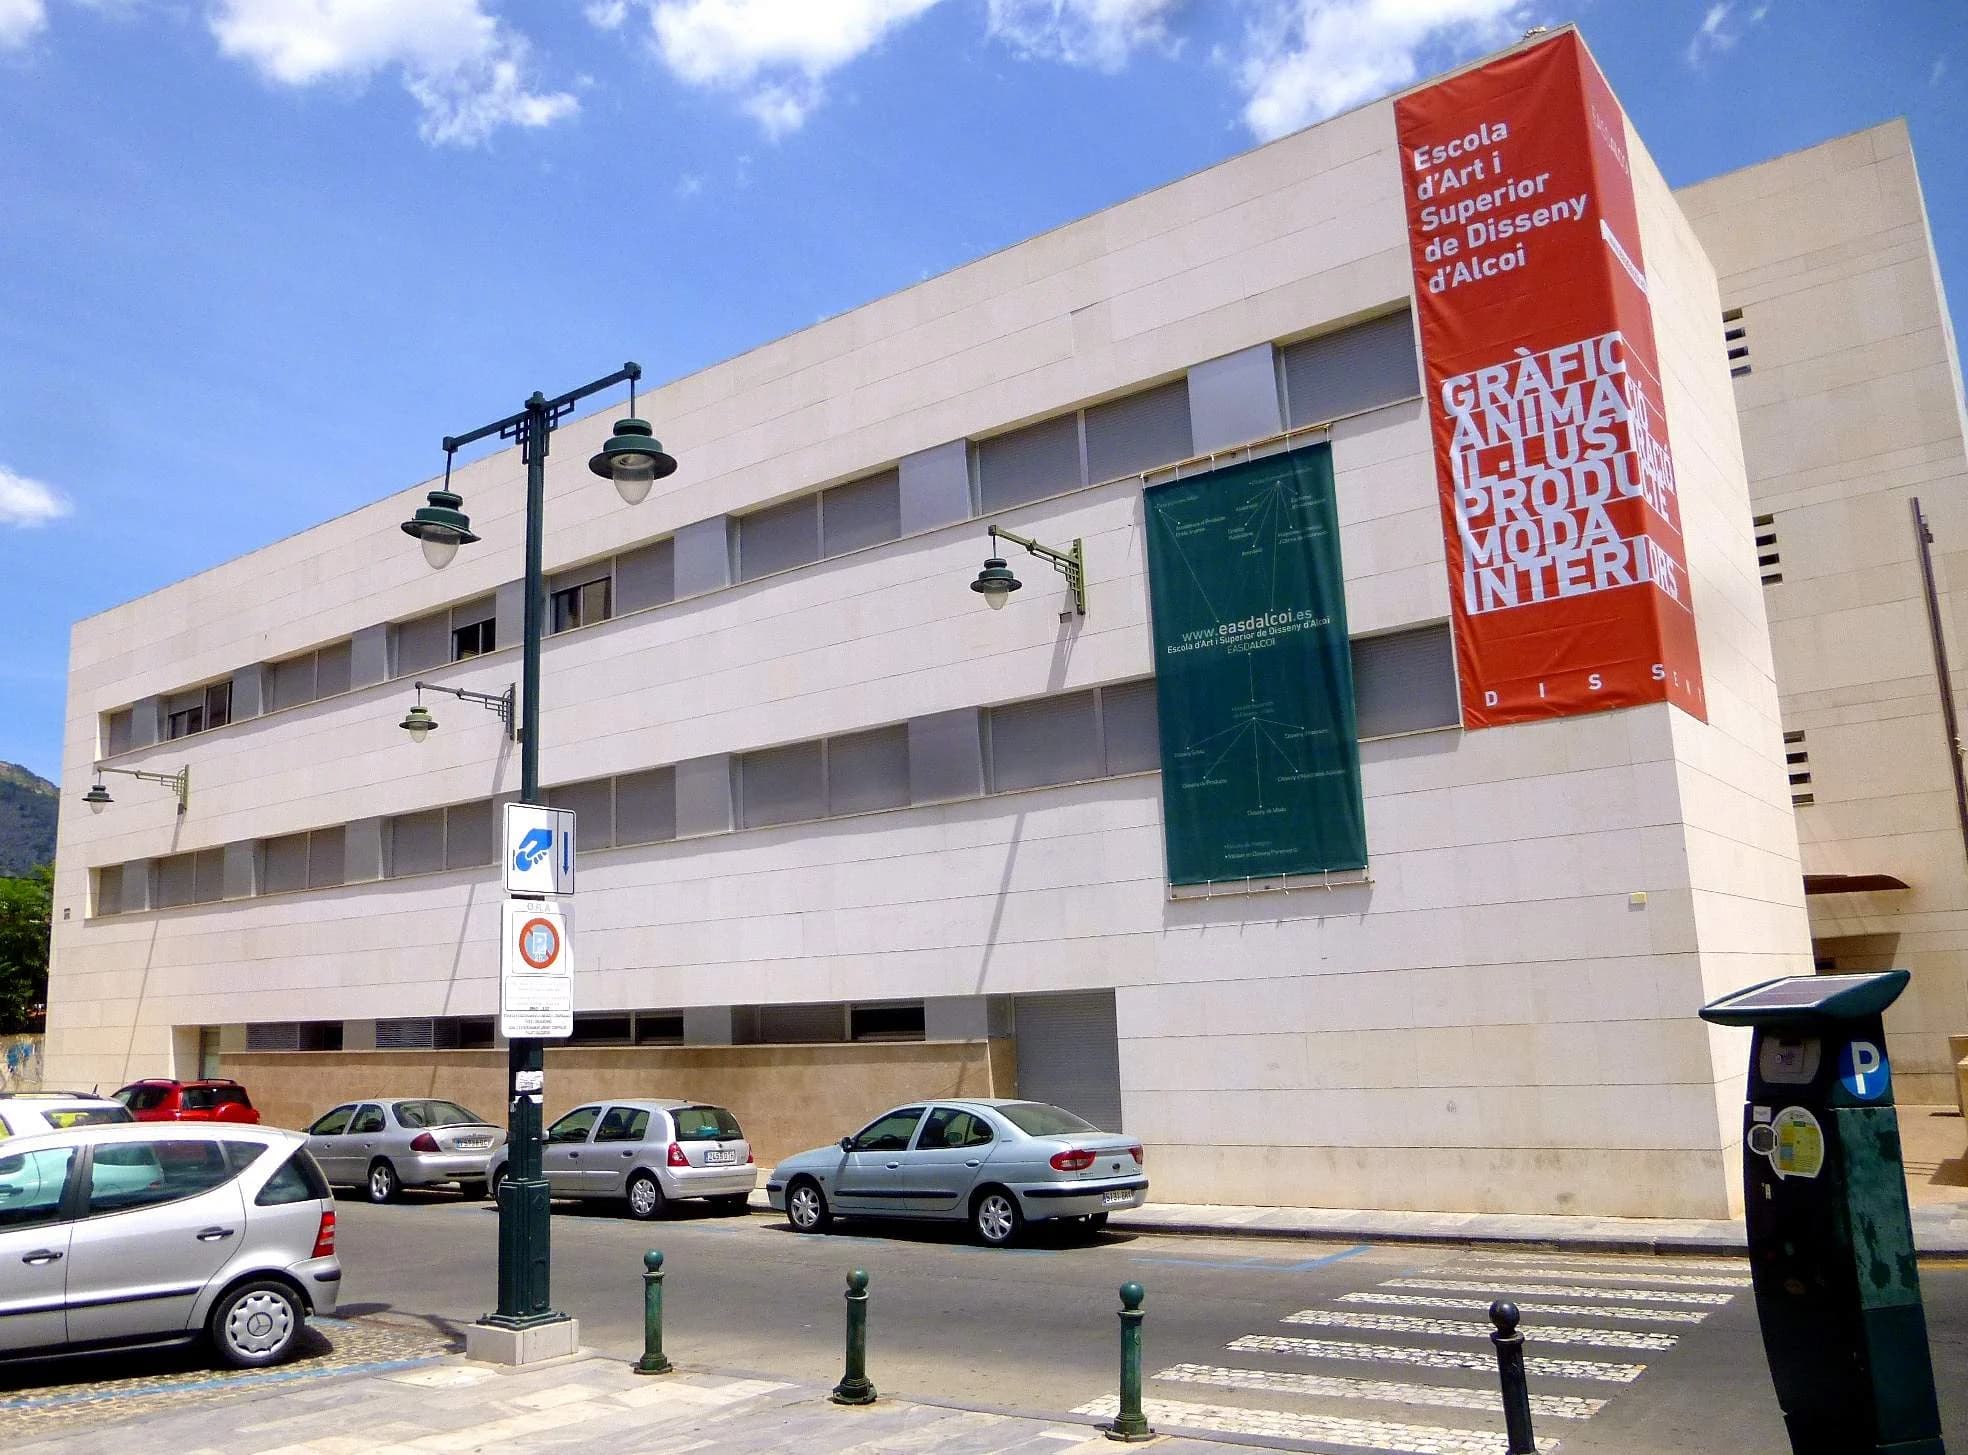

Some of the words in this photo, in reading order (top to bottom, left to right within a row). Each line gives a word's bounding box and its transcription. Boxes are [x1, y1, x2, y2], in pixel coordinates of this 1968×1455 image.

[1414, 122, 1508, 171] Escola
[1417, 158, 1485, 201] d'Art
[1492, 150, 1501, 175] i
[1420, 172, 1550, 232] Superior
[1425, 237, 1459, 263] de
[1467, 193, 1588, 249] Disseny
[1428, 242, 1526, 294] d'Alcoi
[1441, 330, 1627, 418] GRÀFIC
[1460, 503, 1621, 573] MODA
[1167, 643, 1193, 654] Escola
[1194, 638, 1214, 649] d'Art
[1219, 631, 1254, 645] Superior
[1256, 629, 1268, 637] de
[1268, 622, 1302, 636] Disseny
[1303, 616, 1331, 629] d'Alcoi
[1182, 607, 1313, 642] www.easdalcoi.es
[1851, 1041, 1880, 1095] P
